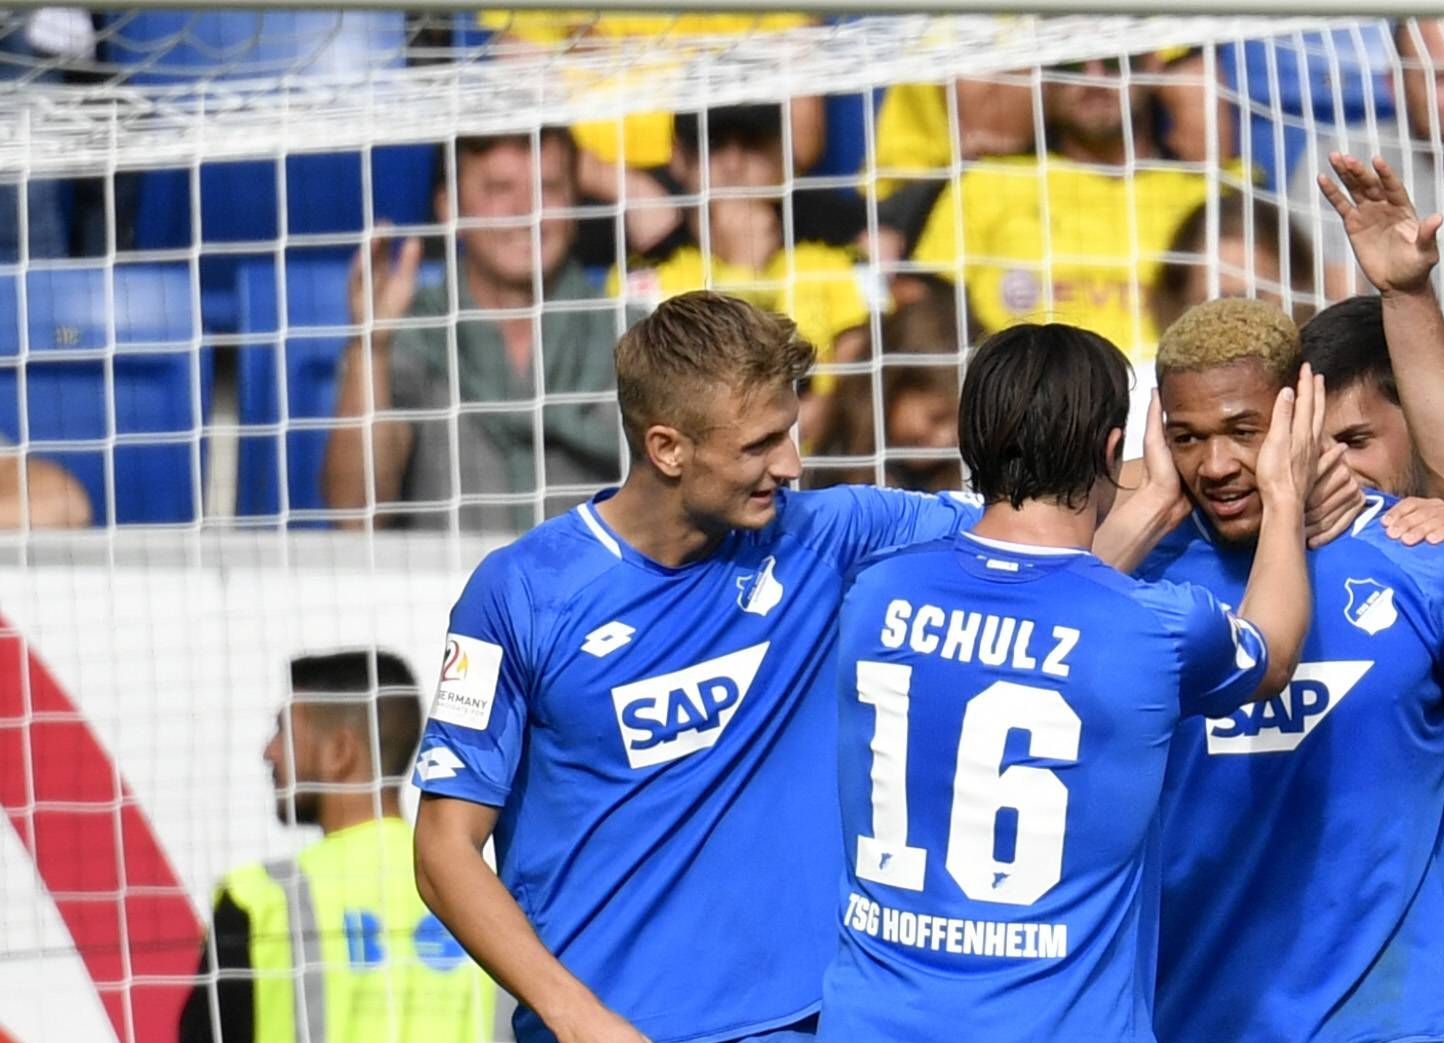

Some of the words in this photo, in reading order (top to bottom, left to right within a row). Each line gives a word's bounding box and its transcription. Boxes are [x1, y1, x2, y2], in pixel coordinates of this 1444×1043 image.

[880, 598, 1081, 677] SCHULZ
[438, 689, 488, 710] ERMANY
[622, 675, 740, 750] SAP
[855, 660, 1082, 906] 16
[844, 893, 881, 939] TSG
[880, 906, 1068, 959] HOFFENHEIM
